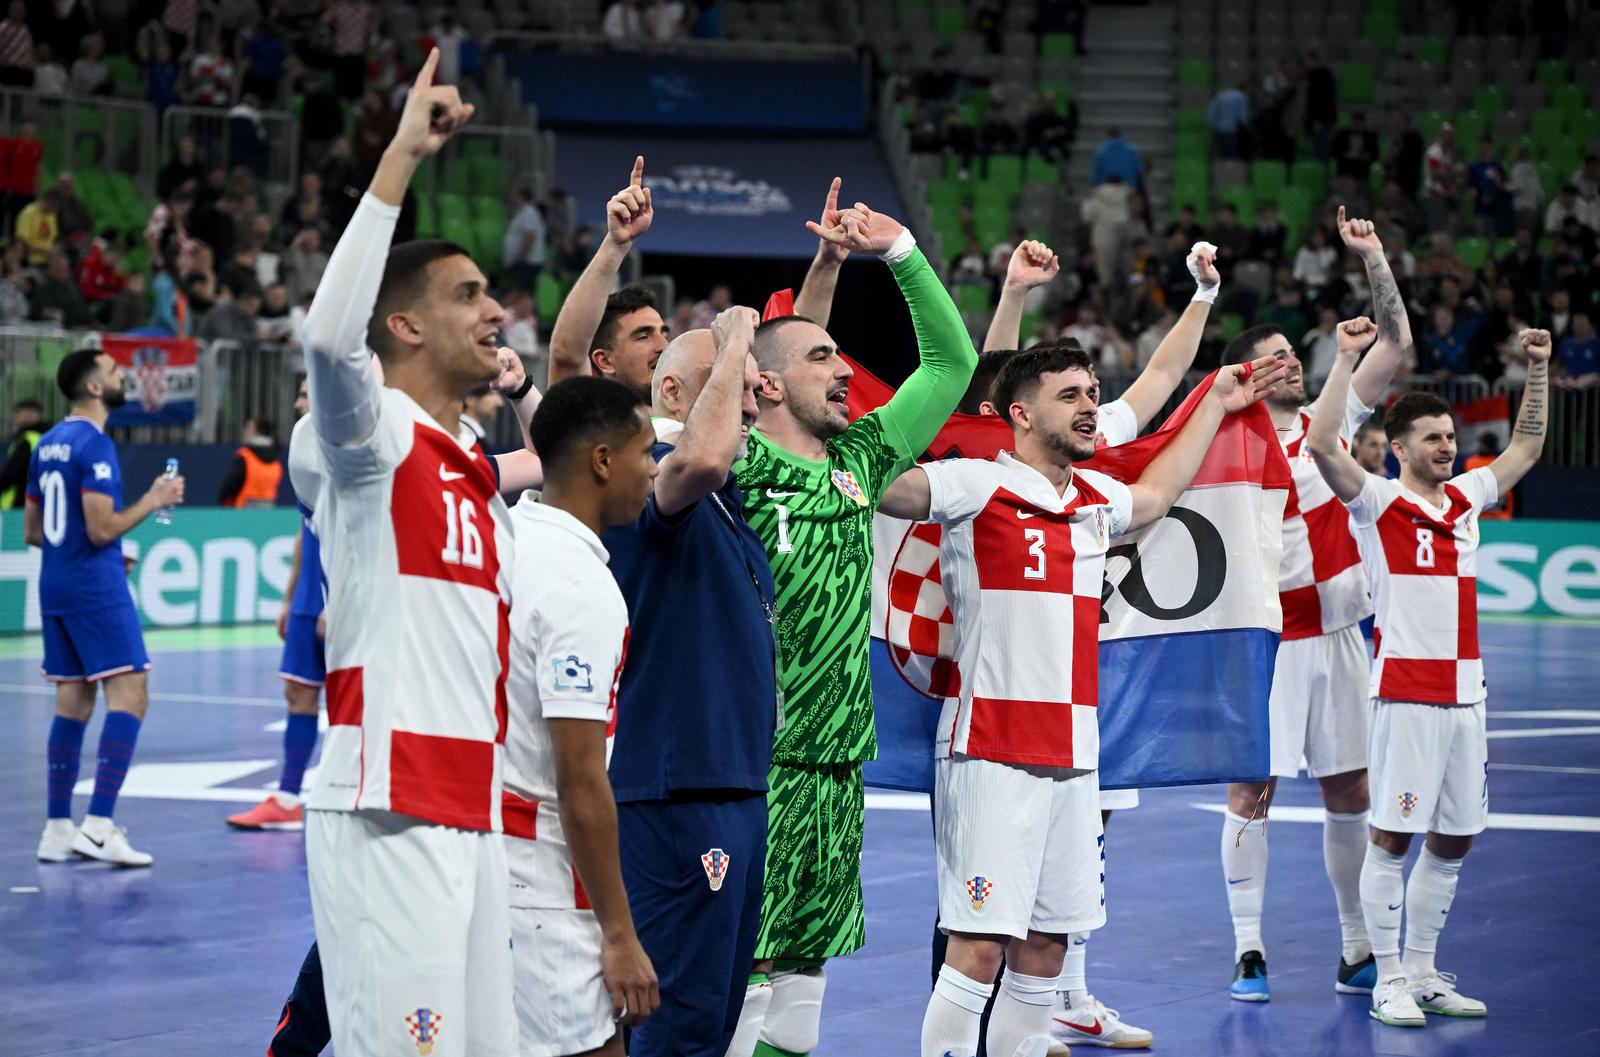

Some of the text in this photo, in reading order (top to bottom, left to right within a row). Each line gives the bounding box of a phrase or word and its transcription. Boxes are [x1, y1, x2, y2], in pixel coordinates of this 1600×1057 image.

[441, 489, 484, 571] 16
[774, 503, 795, 554] 1
[1023, 528, 1047, 580] 3
[1415, 527, 1435, 568] 8
